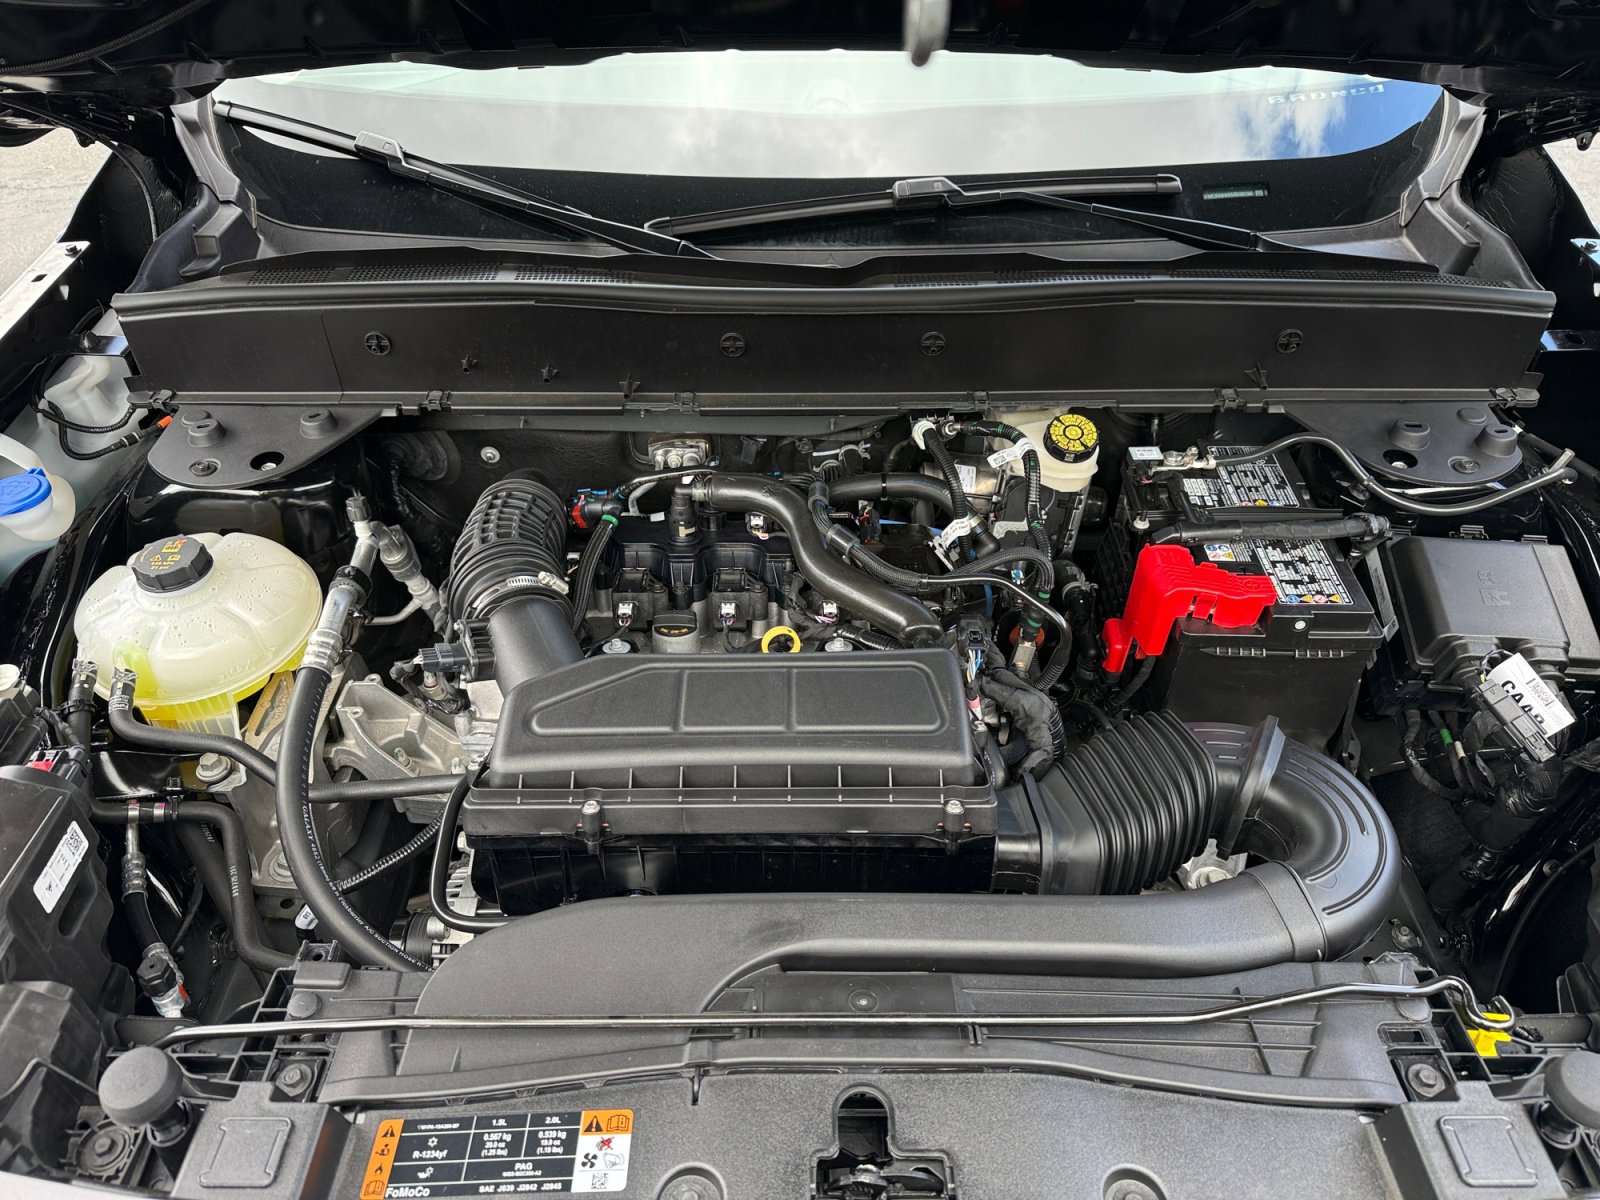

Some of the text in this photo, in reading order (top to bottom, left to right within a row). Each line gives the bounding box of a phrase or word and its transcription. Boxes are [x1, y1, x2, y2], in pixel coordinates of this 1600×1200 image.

[1267, 84, 1385, 105] BRONCO
[302, 805, 315, 843] GALAXY
[364, 924, 375, 935] A/C
[374, 933, 398, 953] SUCTION
[398, 950, 416, 964] HOSE
[492, 1118, 508, 1126] 1.5L
[544, 1116, 562, 1124] 2.0L
[483, 1132, 512, 1142] 0.567 kg
[557, 1130, 567, 1140] kg
[412, 1149, 448, 1160] R-1234yf
[514, 1162, 533, 1170] PAG
[385, 1186, 430, 1198] FoMoCo
[478, 1185, 496, 1193] SAE
[497, 1184, 514, 1192] J639
